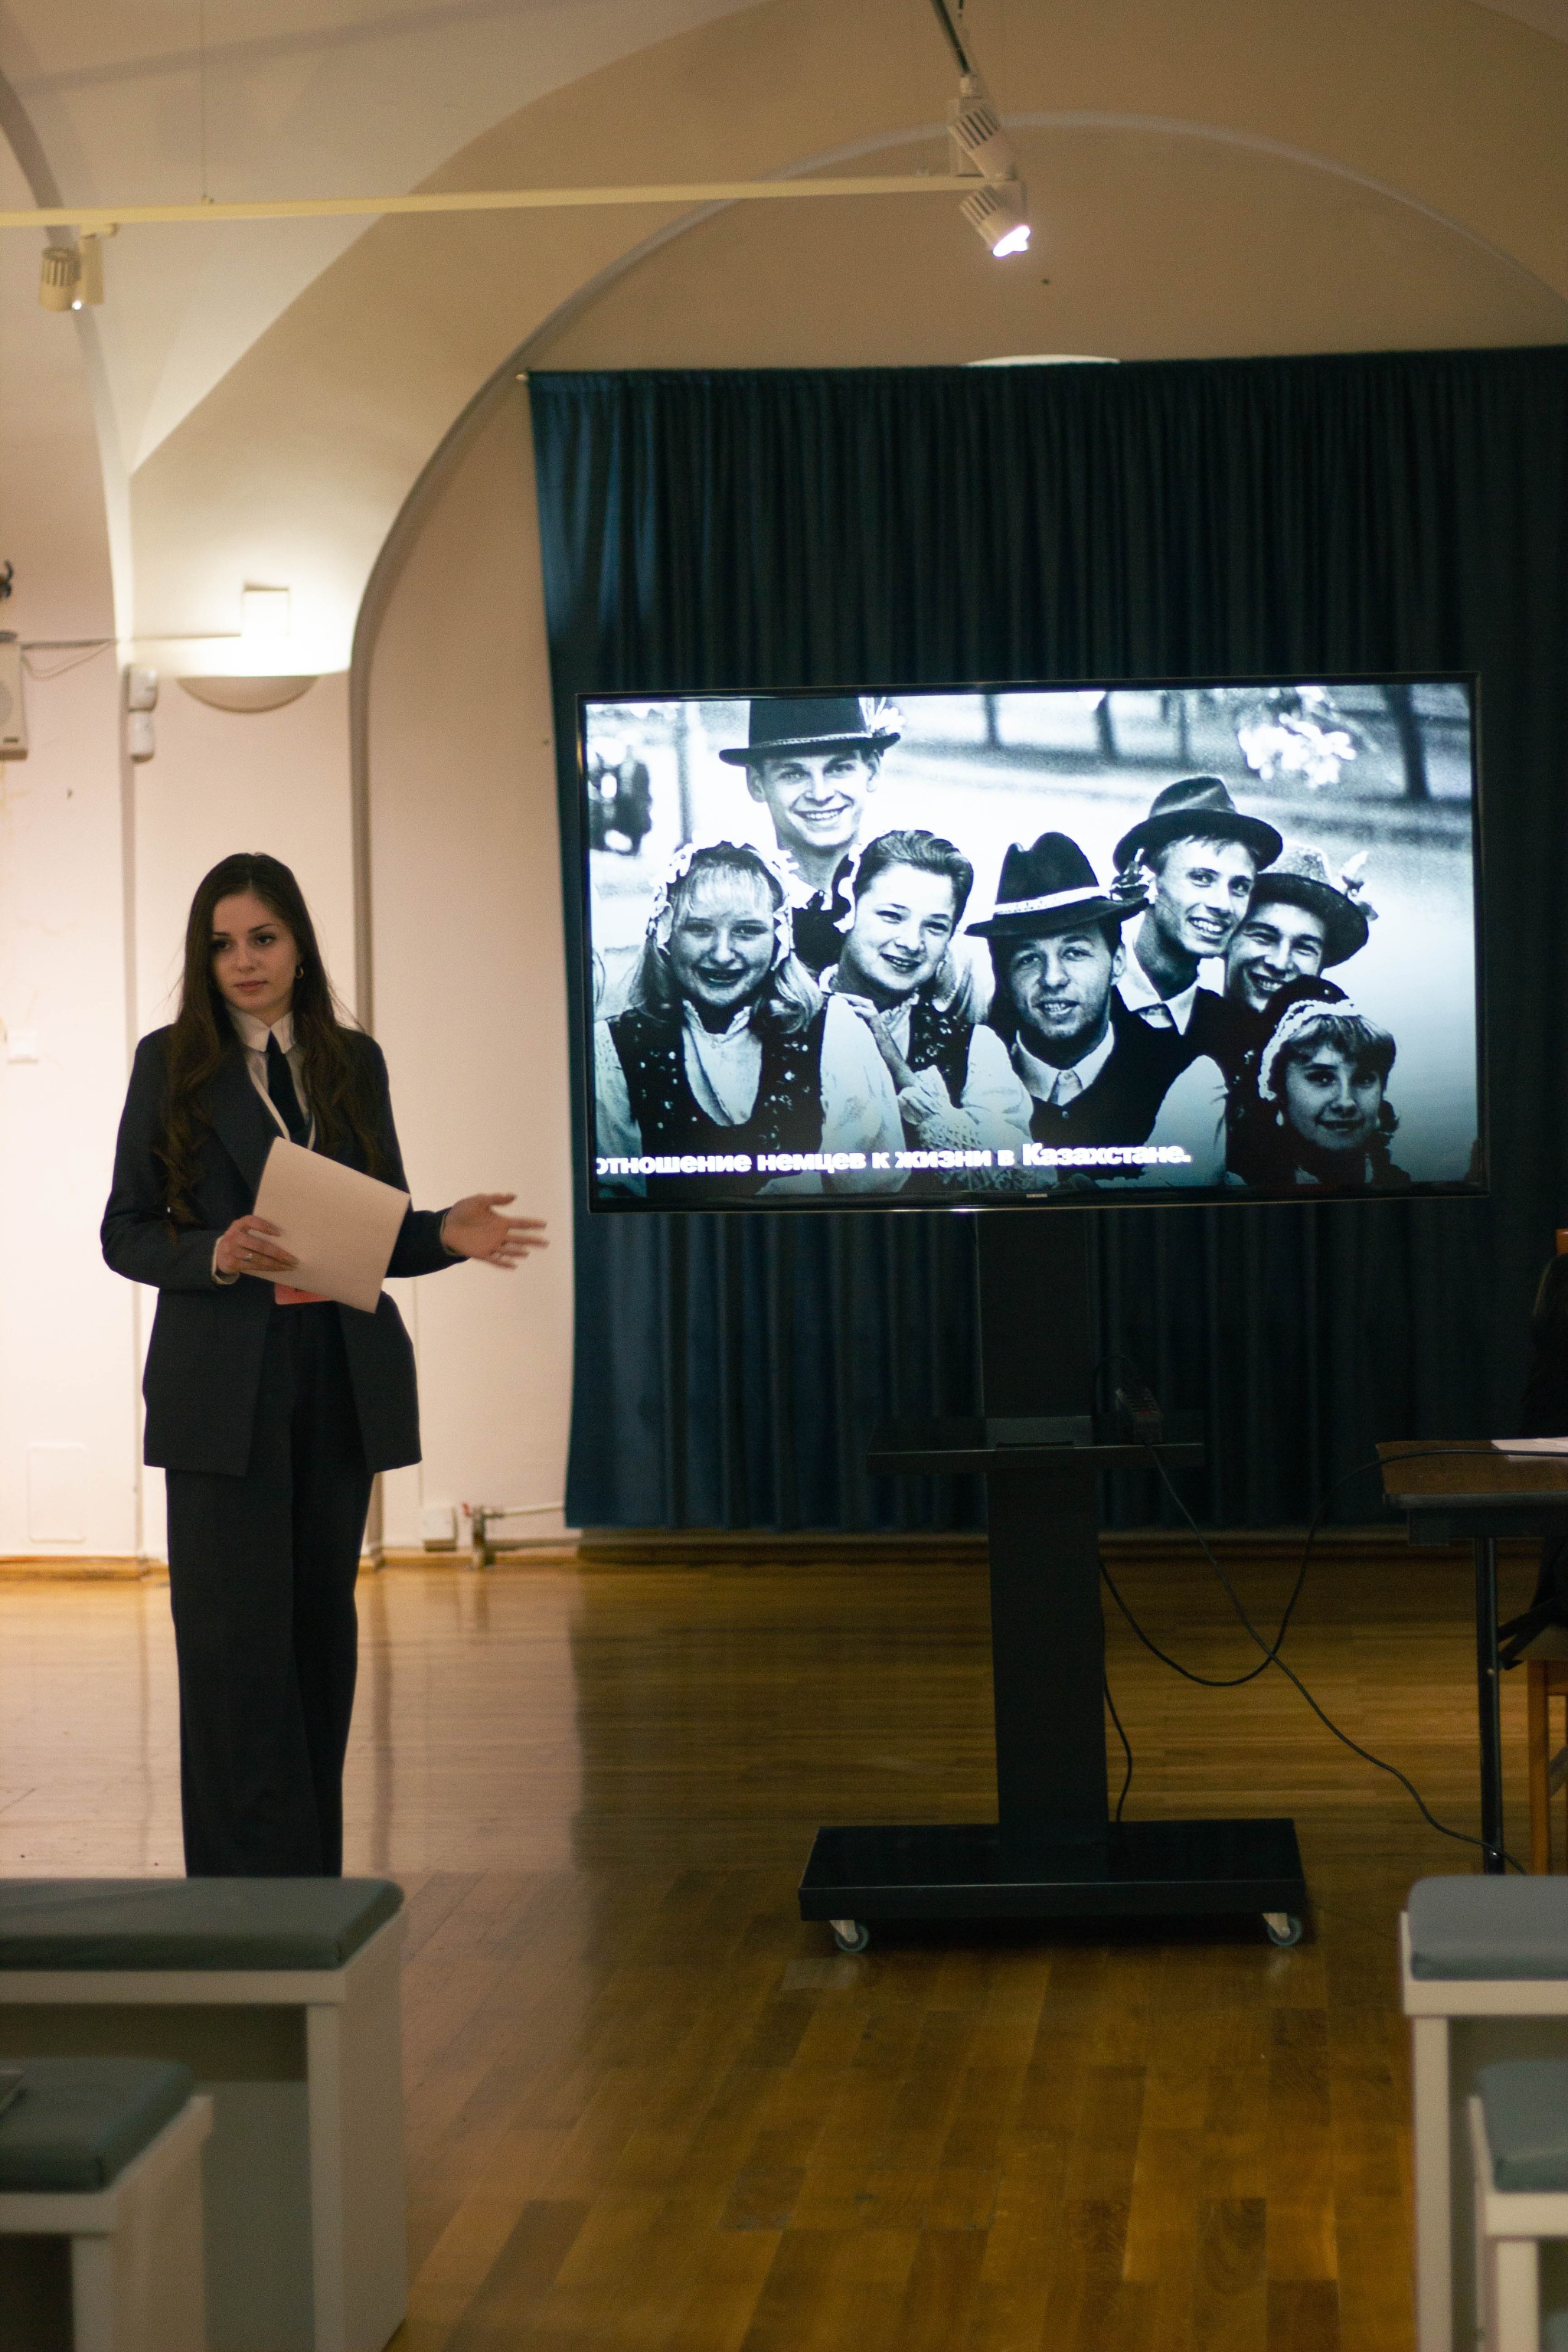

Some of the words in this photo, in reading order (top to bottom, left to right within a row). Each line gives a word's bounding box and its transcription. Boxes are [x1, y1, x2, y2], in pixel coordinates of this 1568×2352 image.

[756, 1152, 867, 1174] немцев
[871, 1152, 890, 1169] к
[894, 1150, 992, 1168] жизни
[997, 1148, 1015, 1167] в
[1022, 1142, 1191, 1166] Казахстане.
